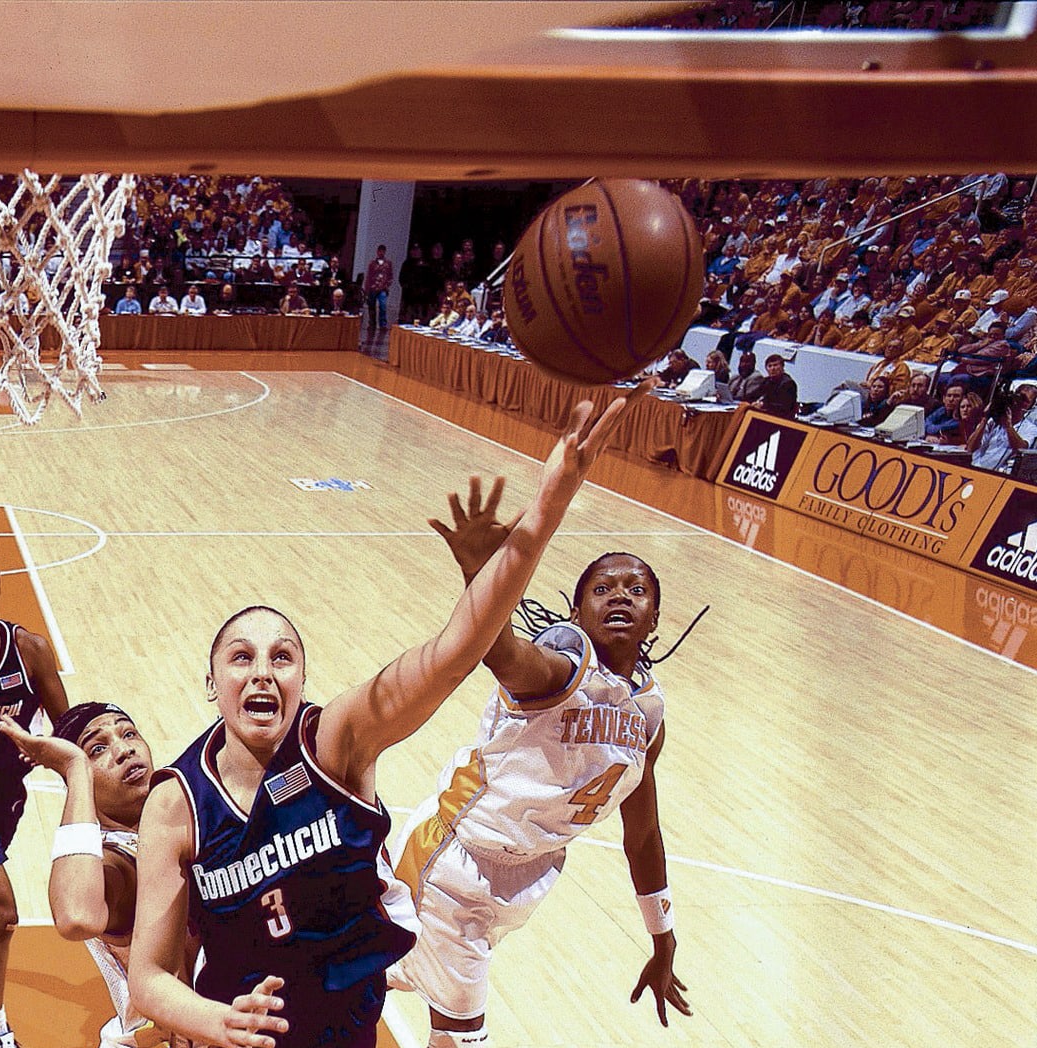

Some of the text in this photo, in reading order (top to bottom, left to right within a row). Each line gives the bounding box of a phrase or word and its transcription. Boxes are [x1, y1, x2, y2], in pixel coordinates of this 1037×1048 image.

[733, 463, 777, 492] adidas
[798, 495, 945, 555] FAMILY CLOTHING
[568, 762, 629, 825] 4
[192, 808, 342, 901] Connecticut
[261, 887, 292, 938] 3
